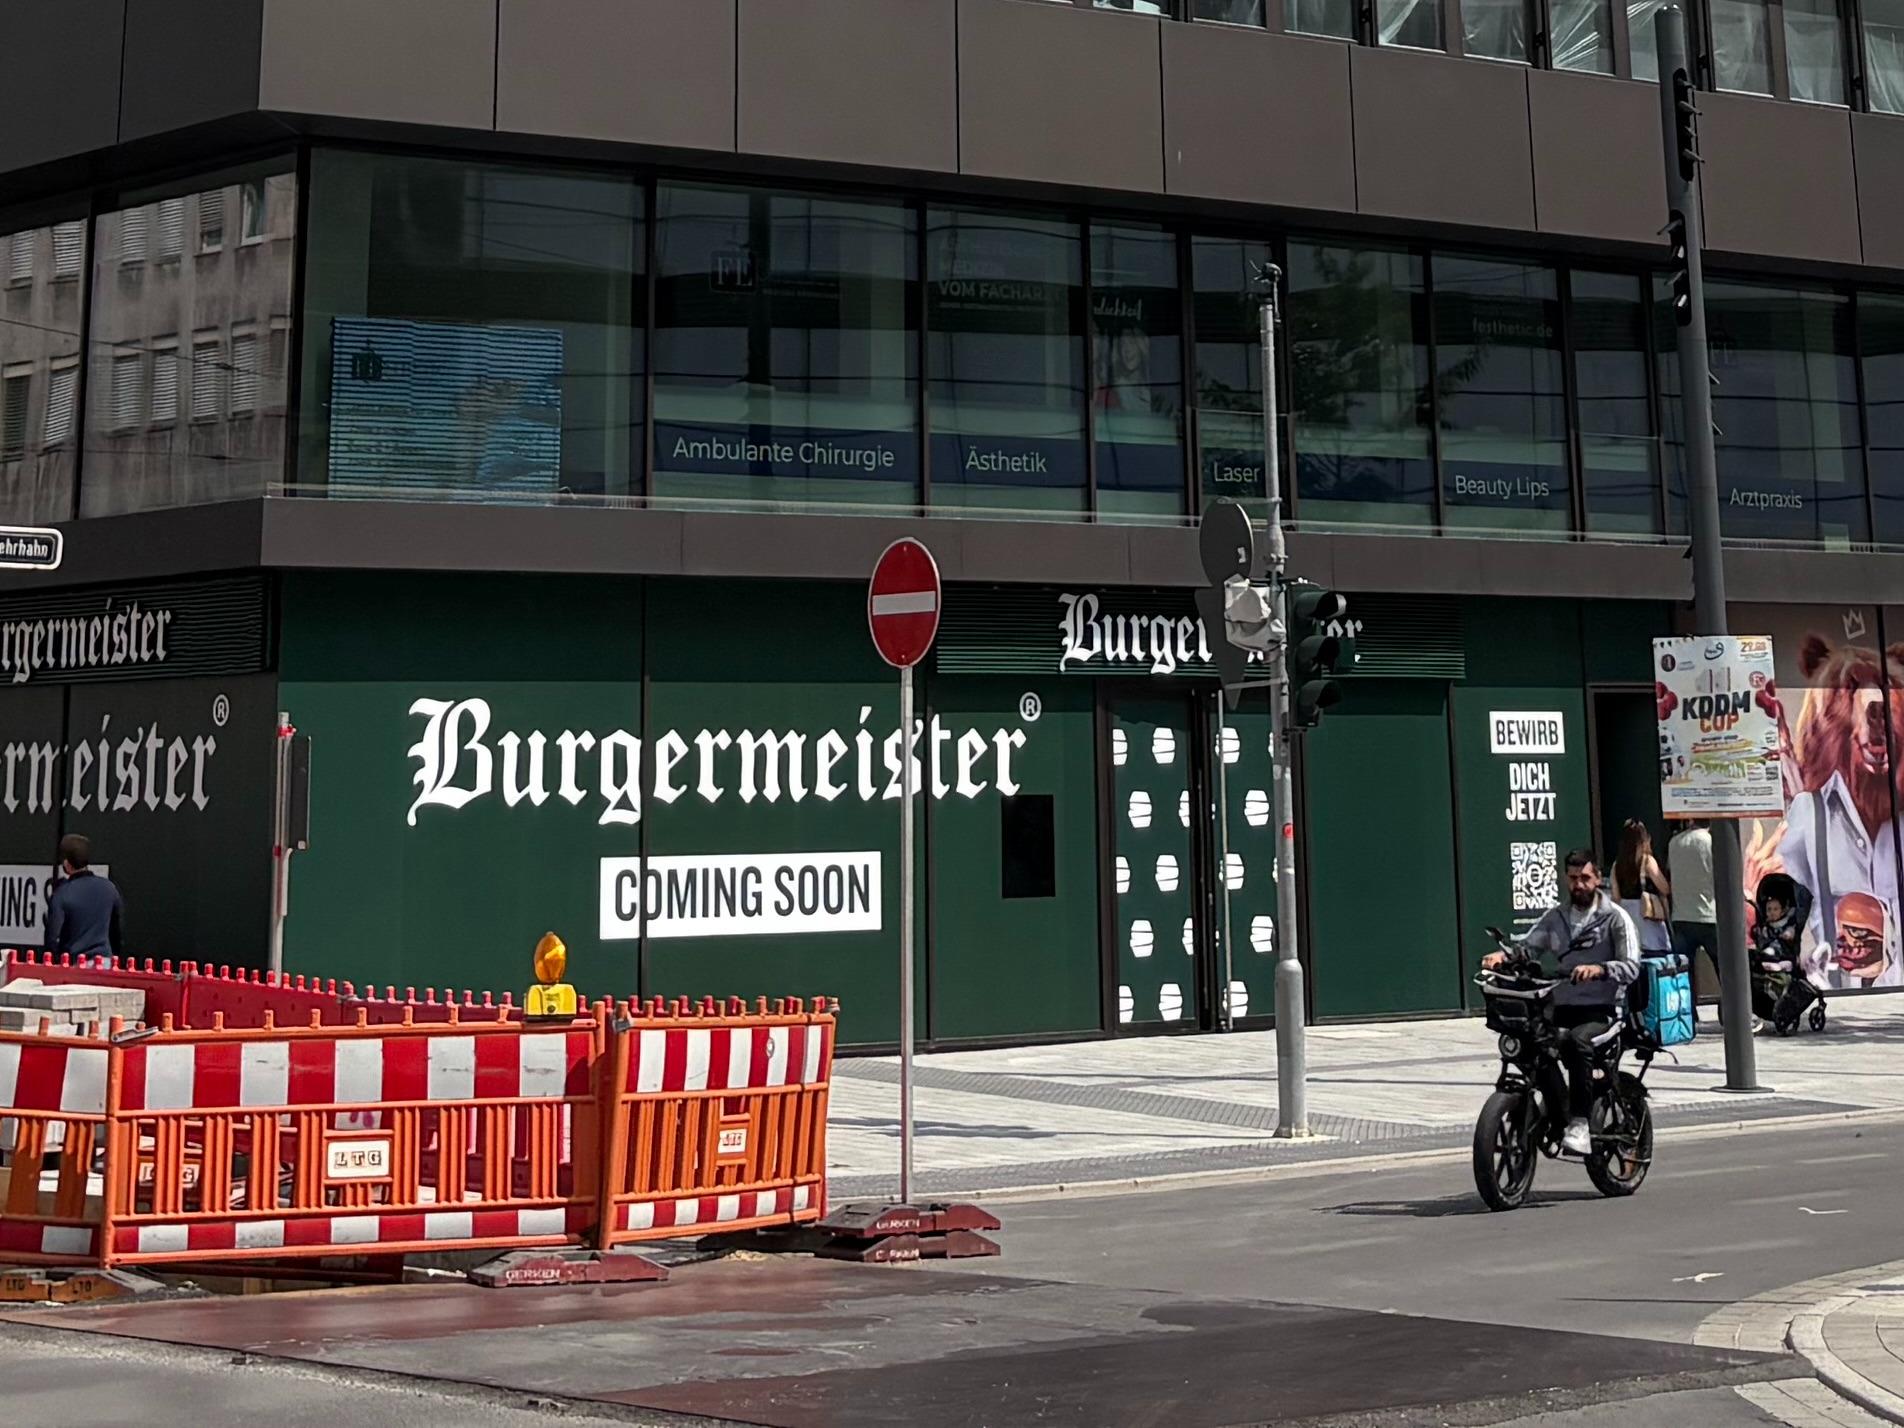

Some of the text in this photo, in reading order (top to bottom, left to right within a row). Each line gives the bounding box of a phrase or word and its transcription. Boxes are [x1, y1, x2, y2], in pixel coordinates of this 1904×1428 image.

[673, 435, 895, 472] Ambulante Chirurgie
[965, 445, 1047, 474] Ästhetik
[1213, 460, 1261, 485] Laser
[1455, 475, 1550, 501] Beauty Lips
[1729, 487, 1803, 511] Arztpraxis
[1494, 719, 1560, 747] BEWIRB
[1699, 713, 1740, 733] CUP
[406, 697, 1028, 827] Burgermeister
[1508, 763, 1551, 792] DICH
[1505, 792, 1557, 821] JETZT
[613, 863, 872, 924] COMING SOON
[334, 1150, 382, 1168] LTG
[505, 1268, 561, 1280] GERKEN
